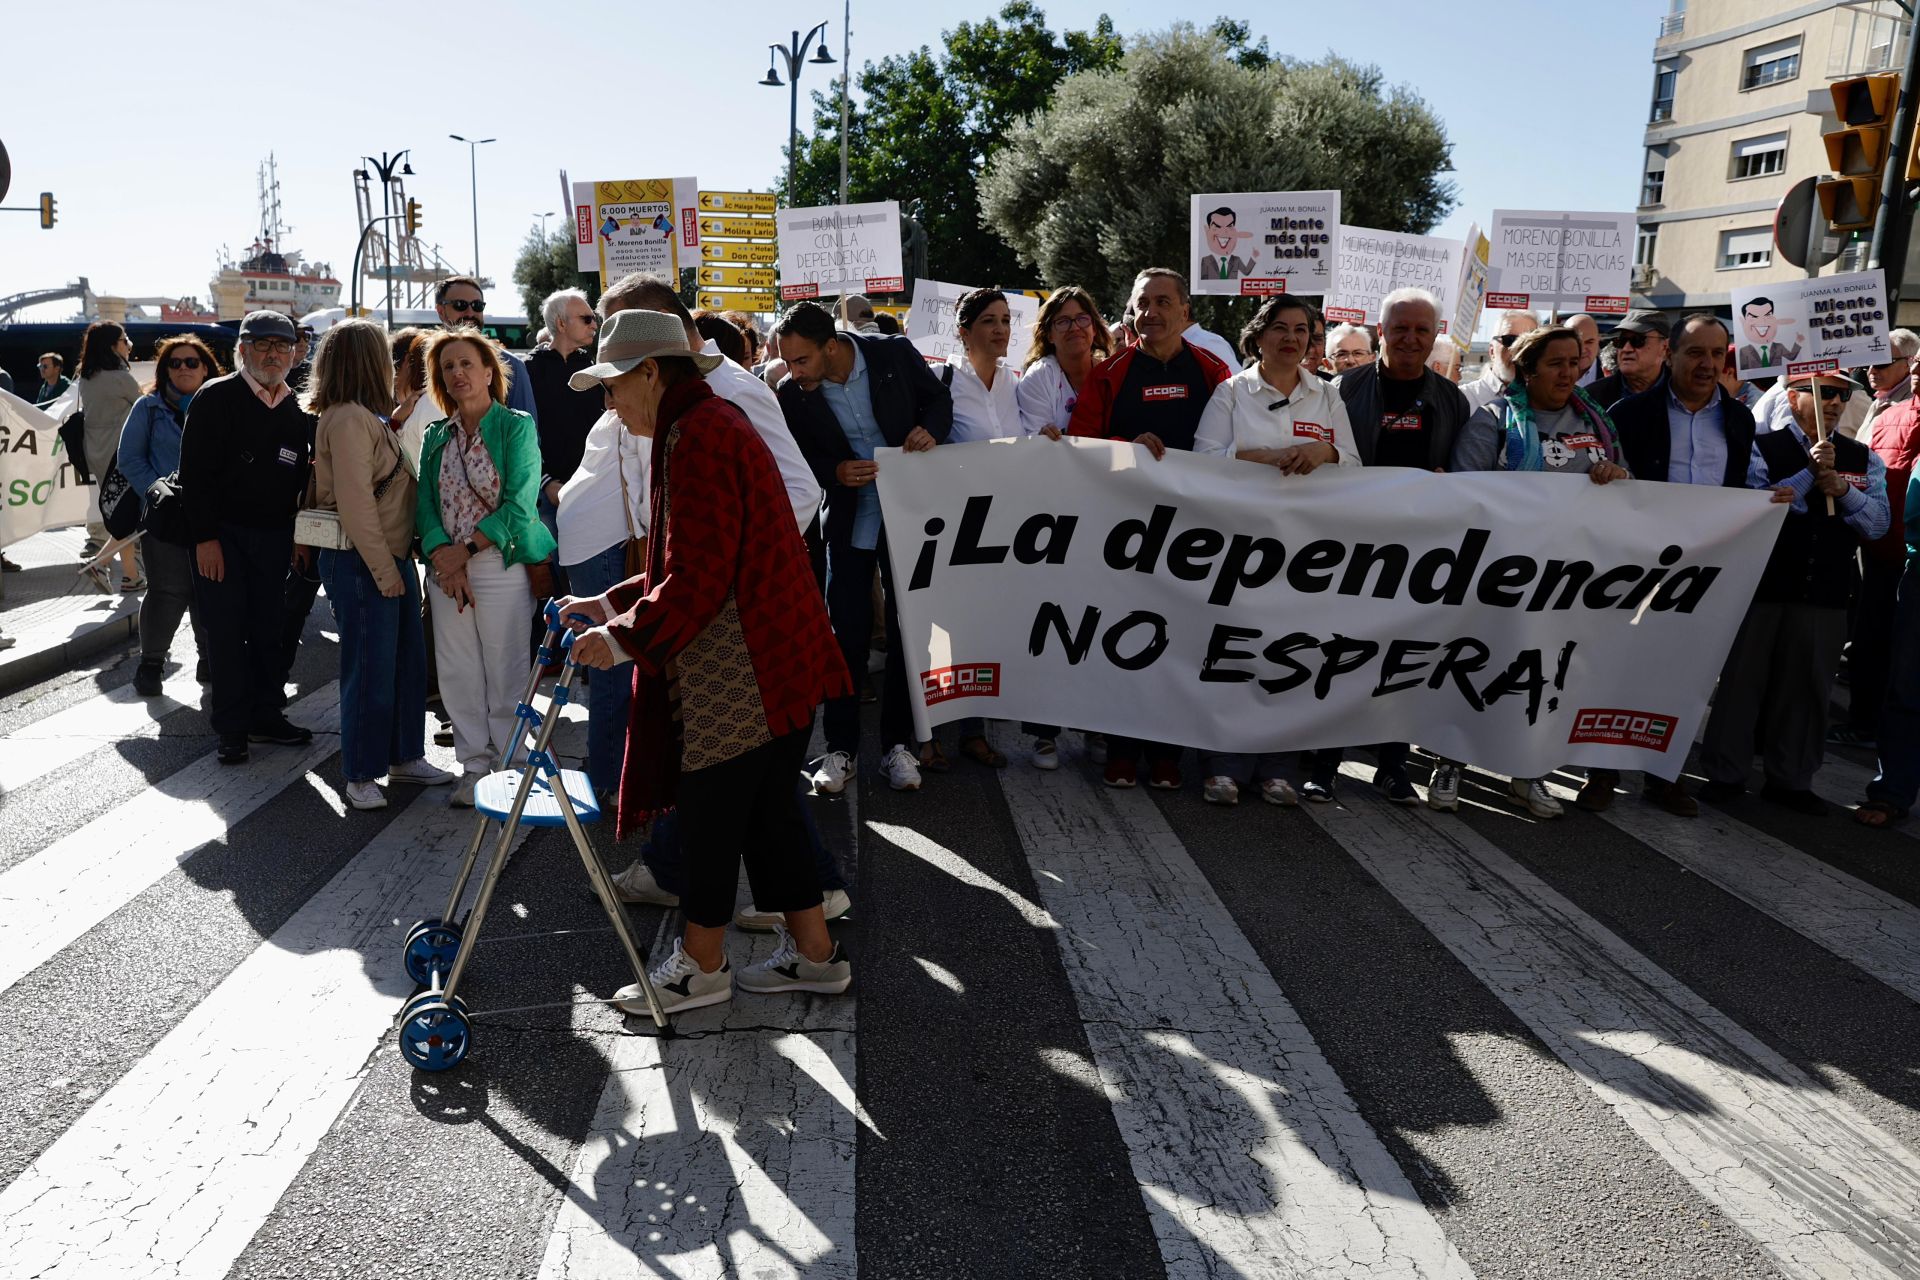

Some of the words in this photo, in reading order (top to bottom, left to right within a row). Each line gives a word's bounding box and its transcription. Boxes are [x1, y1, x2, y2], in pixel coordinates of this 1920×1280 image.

[602, 207, 626, 215] 8.000
[628, 204, 669, 214] MUERTOS
[812, 215, 864, 231] BONILLA
[1270, 217, 1324, 230] Miente
[724, 227, 752, 236] Molina
[1265, 231, 1295, 244] más
[1300, 234, 1329, 247] que
[1504, 229, 1560, 246] MORENO
[1562, 230, 1622, 248] BONILLA
[644, 238, 667, 246] Bonilla
[814, 234, 838, 249] CON
[732, 252, 748, 260] Don
[751, 253, 774, 261] Curro
[1274, 244, 1320, 259] habla
[1342, 236, 1393, 257] MORENO
[1394, 241, 1449, 264] BONILLA
[796, 250, 878, 269] DEPENDENCIA
[1536, 252, 1625, 271] RESIDENCIAS
[803, 270, 820, 285] NO
[1392, 261, 1443, 283] ESPERA
[738, 278, 764, 286] Carlos
[867, 280, 894, 288] CCOO
[1244, 280, 1275, 288] CCOO
[784, 286, 810, 294] CCOO
[1800, 289, 1832, 299] JUANMA
[1844, 284, 1877, 294] BONILLA
[758, 302, 774, 310] Sur
[1488, 294, 1519, 304] CCOO
[1588, 298, 1618, 307] CCOO
[1814, 296, 1876, 314] Miente
[1810, 312, 1846, 328] más
[1850, 310, 1884, 325] que
[1822, 324, 1874, 341] habla
[1790, 362, 1826, 374] CCOO
[1145, 386, 1177, 396] CCOO
[1296, 424, 1324, 438] CCOO
[1564, 436, 1596, 445] CCOO
[908, 496, 1079, 592] ¡La
[1103, 504, 1722, 614] dependencia
[1029, 602, 1170, 670] NO
[1199, 624, 1578, 726] ESPERA!
[962, 684, 992, 693] Málaga
[1577, 714, 1650, 733] CCOO
[1574, 730, 1624, 740] Pensionistas
[1630, 732, 1662, 746] Málaga
